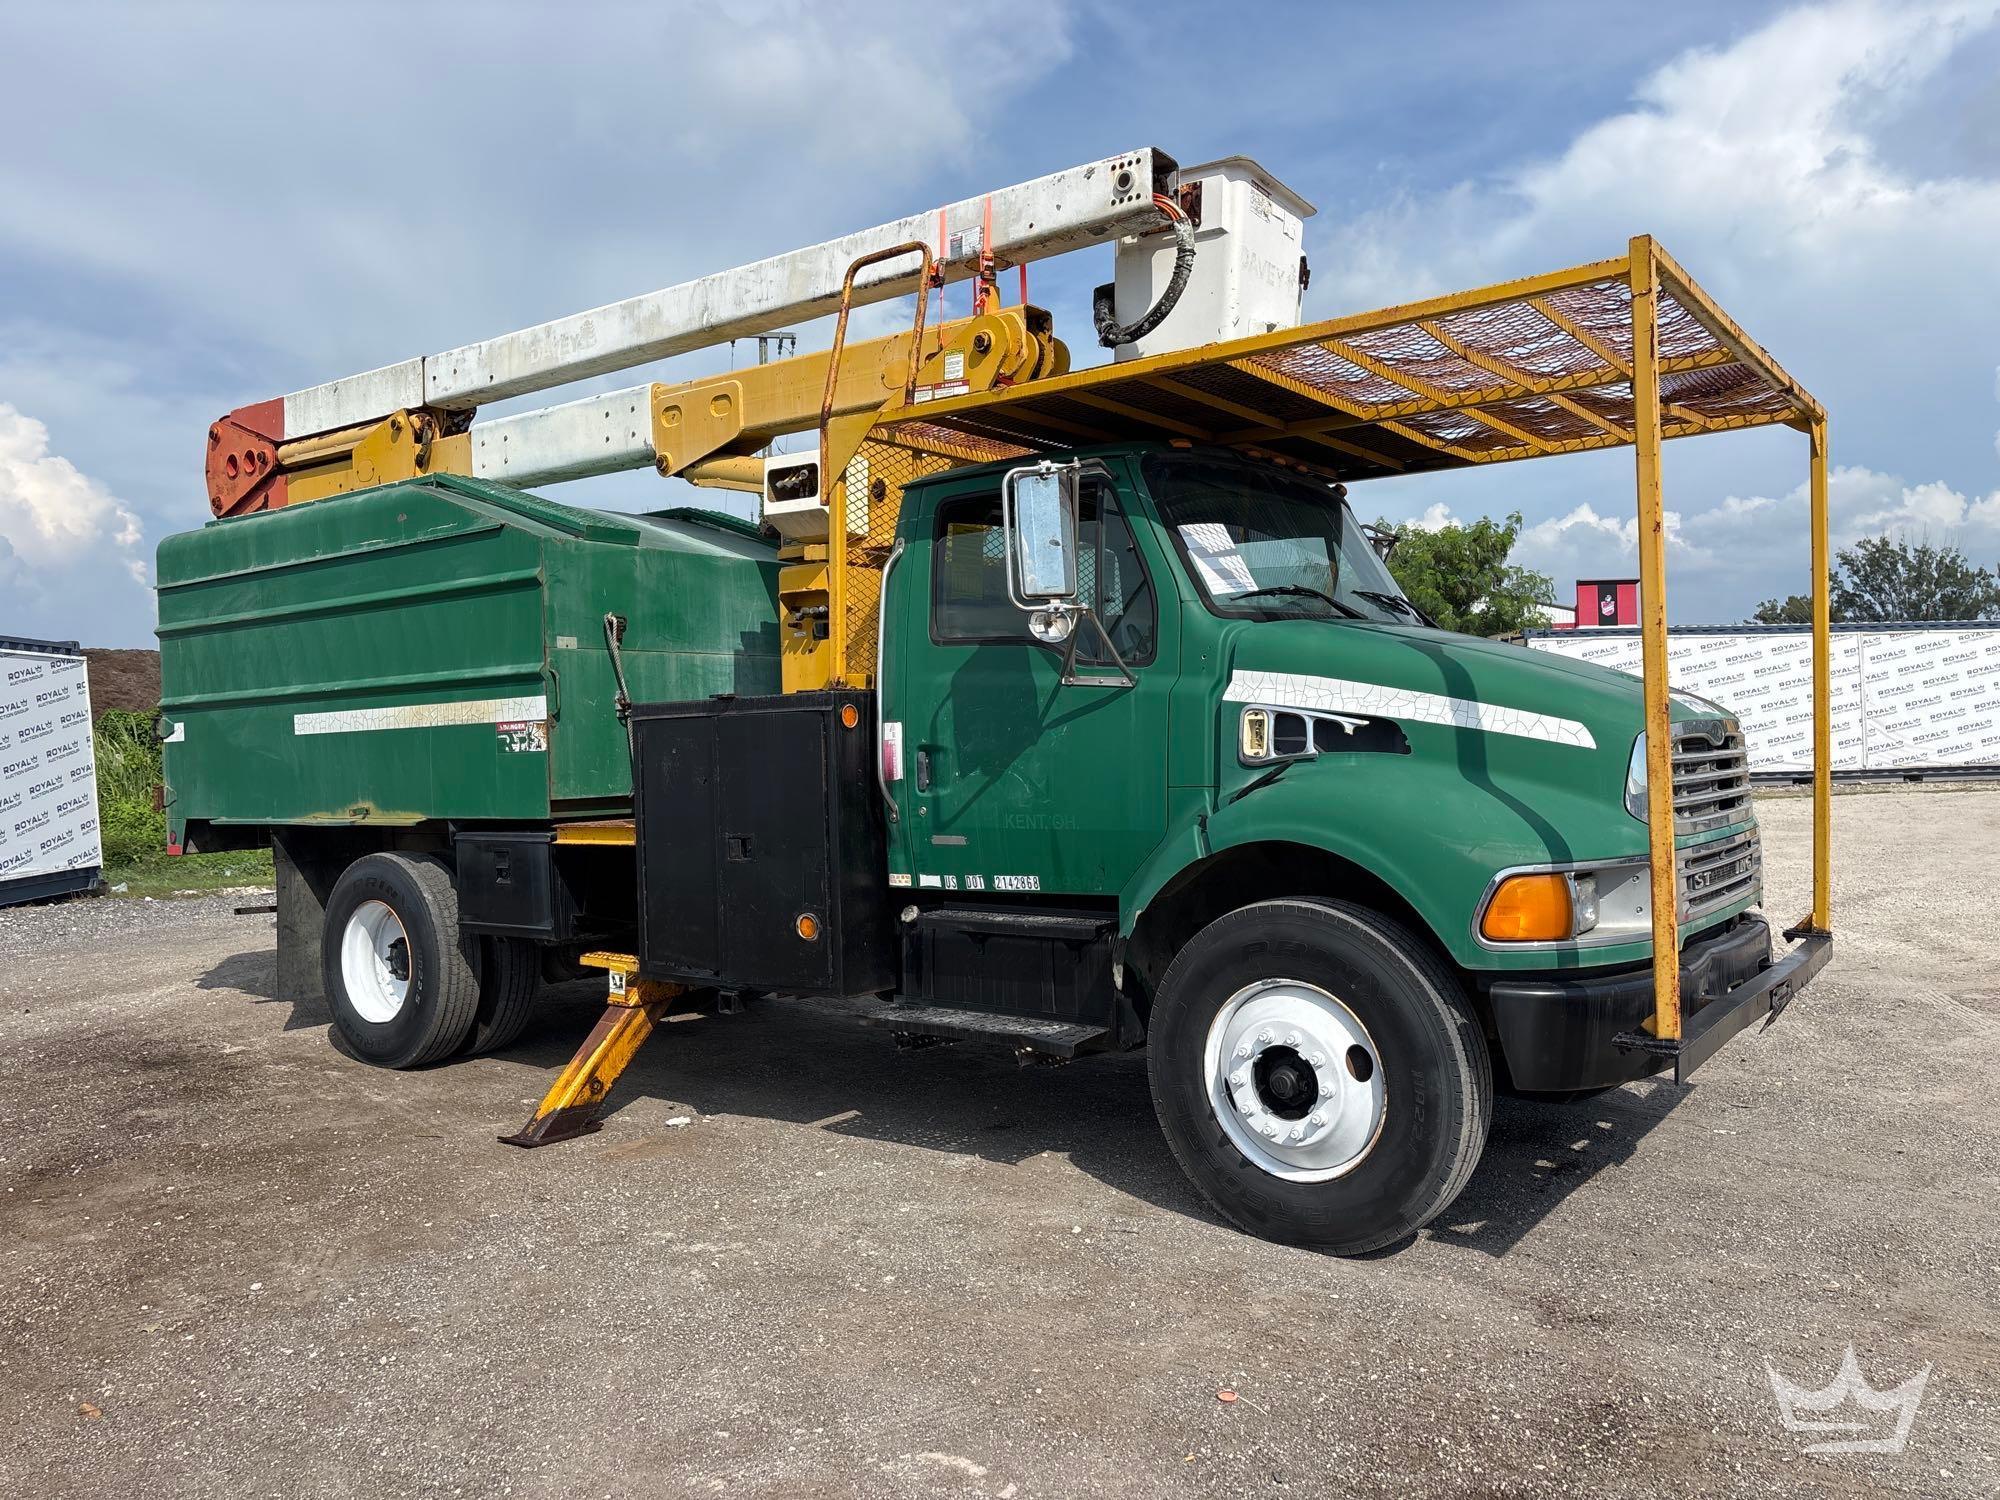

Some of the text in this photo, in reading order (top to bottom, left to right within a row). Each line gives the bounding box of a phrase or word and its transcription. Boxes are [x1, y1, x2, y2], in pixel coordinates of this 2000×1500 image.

[8, 668, 35, 680] ROYAL
[36, 689, 62, 702] ROYAL
[0, 702, 20, 714] OYAL
[61, 711, 85, 724] ROYAL
[19, 723, 45, 738] ROYAL
[46, 744, 72, 758] ROYAL
[3, 759, 31, 774] ROYAL
[29, 779, 56, 794] ROYAL
[57, 797, 82, 812] ROYAL
[15, 815, 42, 832] ROYAL
[80, 818, 97, 831] ROY
[40, 833, 66, 850] ROYAL
[945, 876, 957, 888] US
[996, 876, 1039, 890] 2142868
